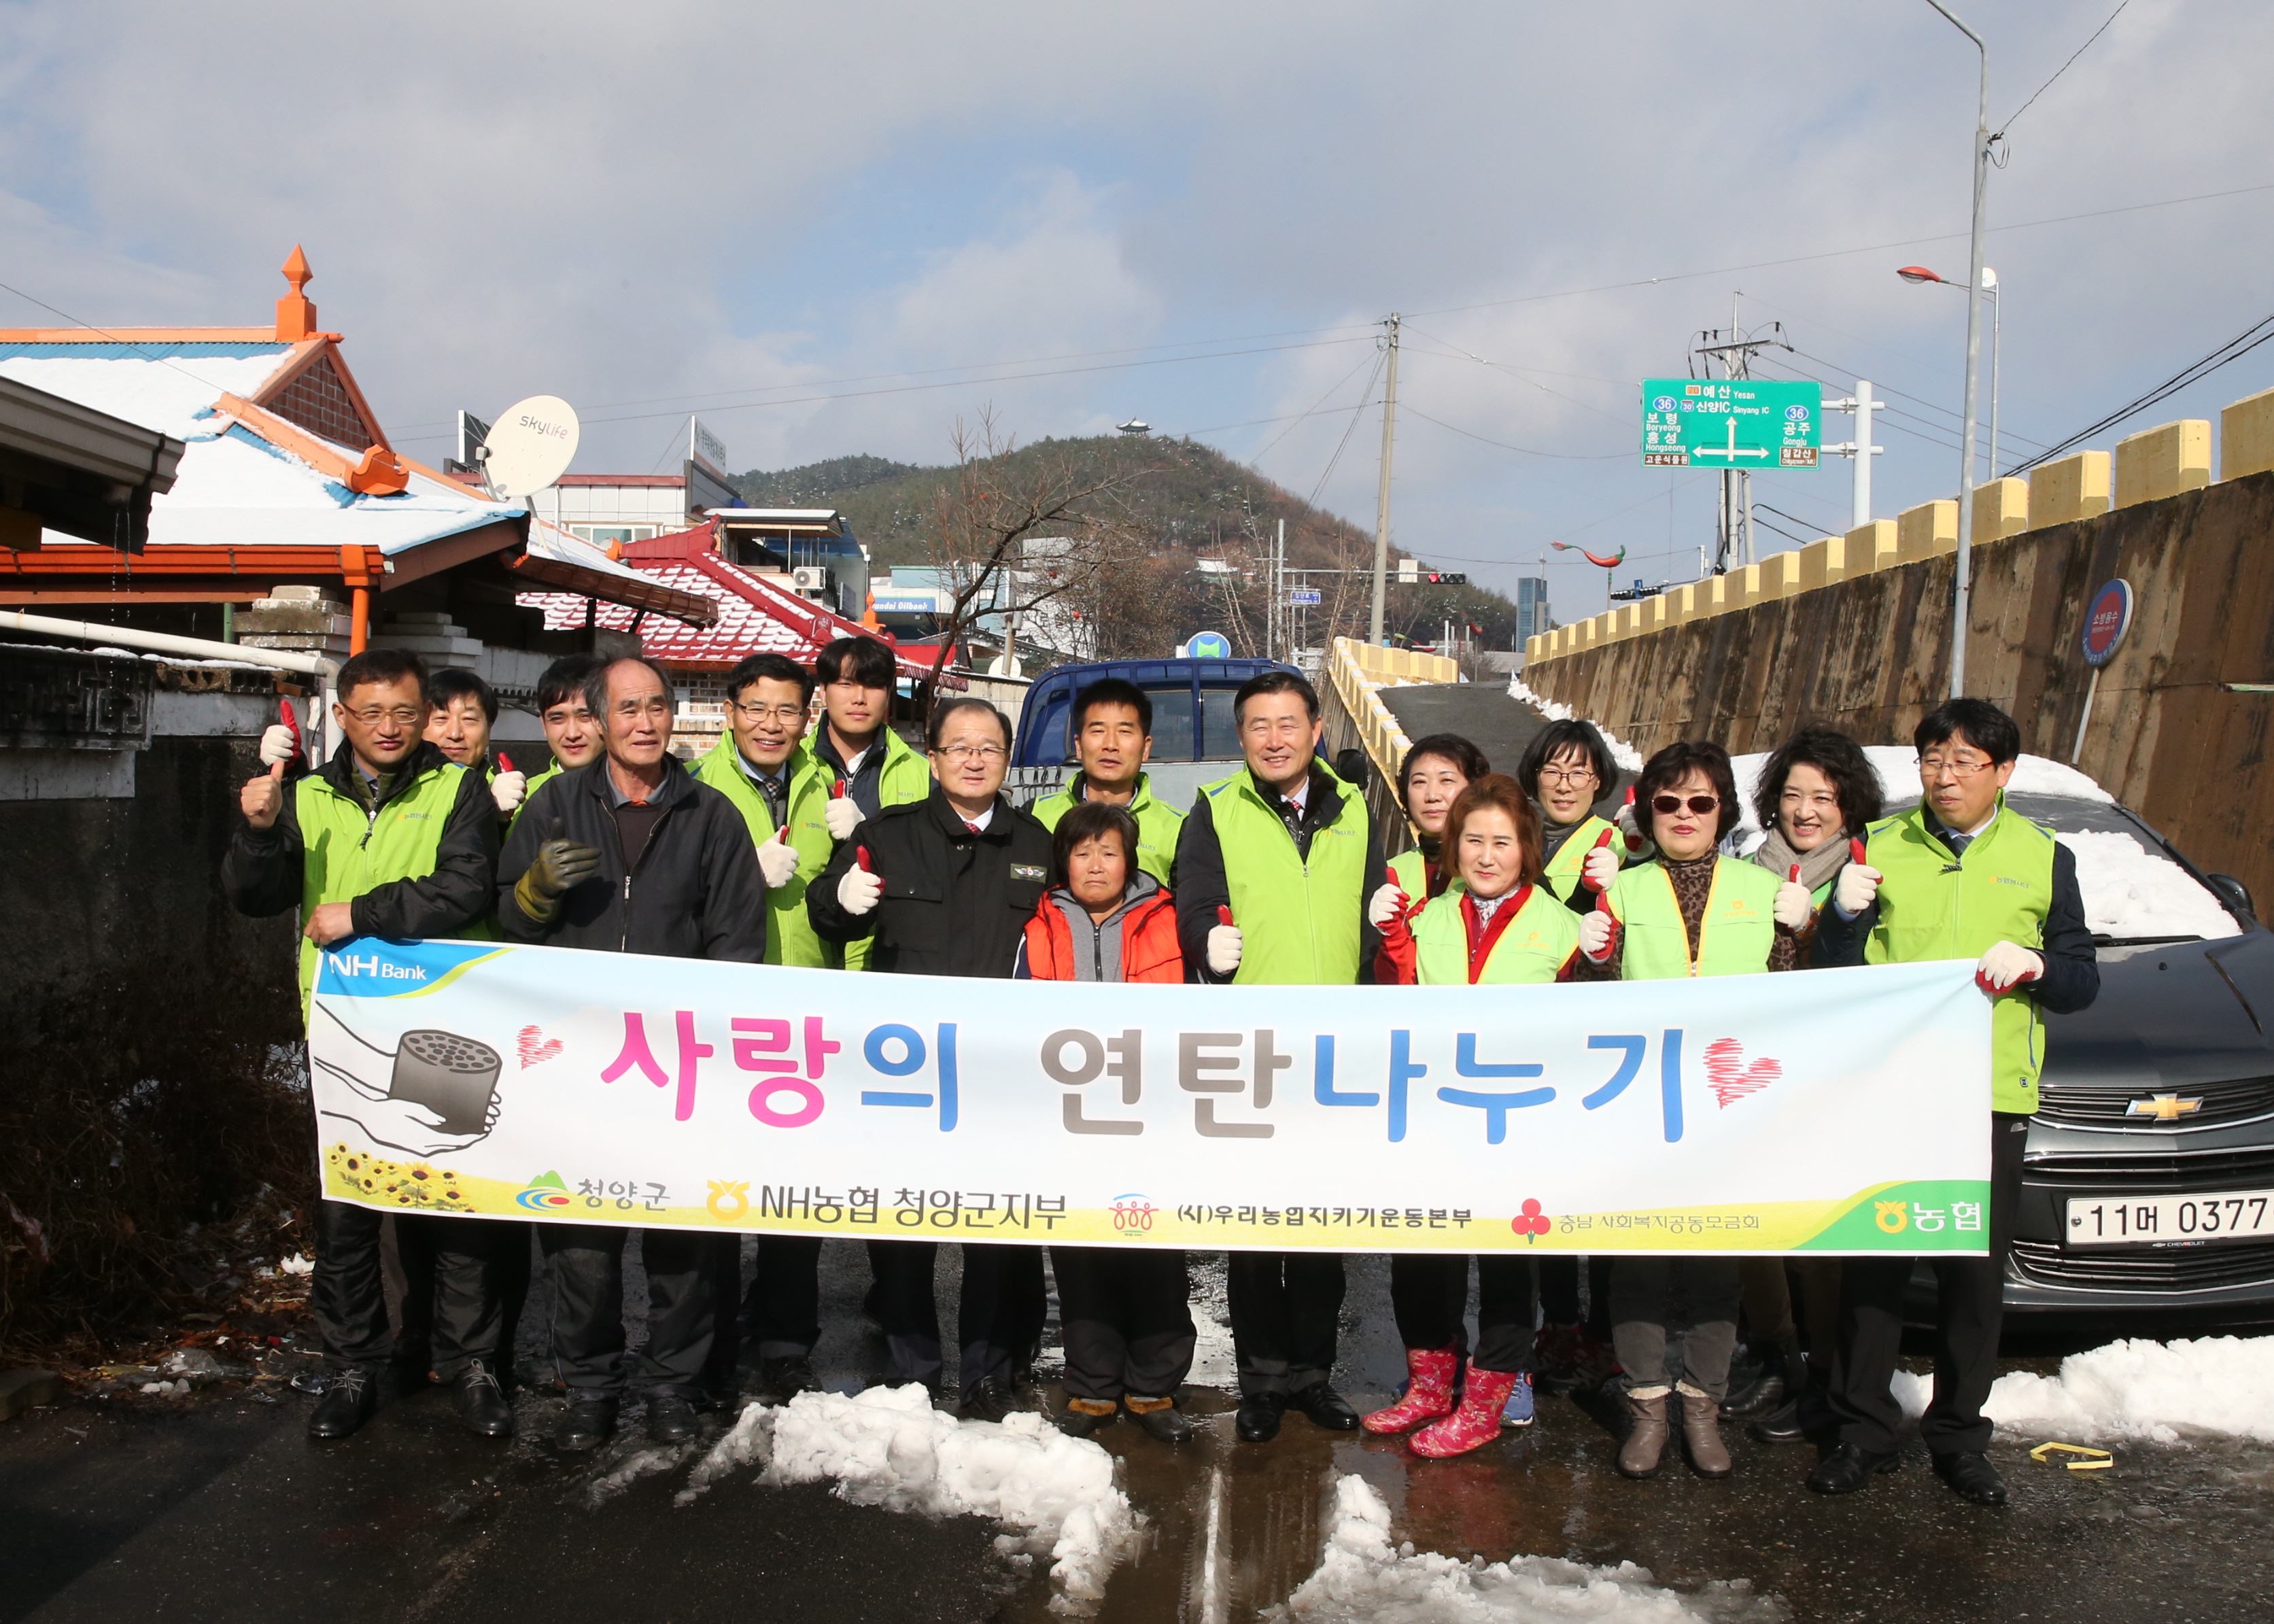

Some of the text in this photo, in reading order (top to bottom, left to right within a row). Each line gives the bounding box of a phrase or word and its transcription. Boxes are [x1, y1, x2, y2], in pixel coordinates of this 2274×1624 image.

[1703, 385, 1731, 399] 예산
[1733, 391, 1755, 400] Yesan
[1657, 398, 1672, 410] 36
[1695, 401, 1731, 413] 신양IC
[1733, 406, 1760, 415] Sinyang
[1646, 412, 1678, 425] 보령
[1789, 408, 1804, 419] 36
[519, 415, 568, 440] skylife
[1646, 424, 1681, 432] Boryeong
[1782, 421, 1811, 436] 공주
[1647, 431, 1677, 444] 홍성
[1782, 436, 1807, 447] Gongju
[1645, 443, 1686, 453] Hongseong
[1782, 449, 1812, 459] 칠갑산
[1645, 455, 1689, 464] 고운식물원
[871, 601, 928, 610] undai Oilbank
[2092, 611, 2118, 625] 소방용수
[328, 953, 428, 980] NH Bank
[600, 1010, 1684, 1145] 사랑의 연탄나누기
[577, 1178, 671, 1212] 청양군
[761, 1185, 1067, 1230] NH농협 청양군지부
[1913, 1201, 1981, 1232] 농협
[2090, 1197, 2269, 1237] 11머 0377
[1558, 1214, 1760, 1234] 충남 사회복지공동모금회
